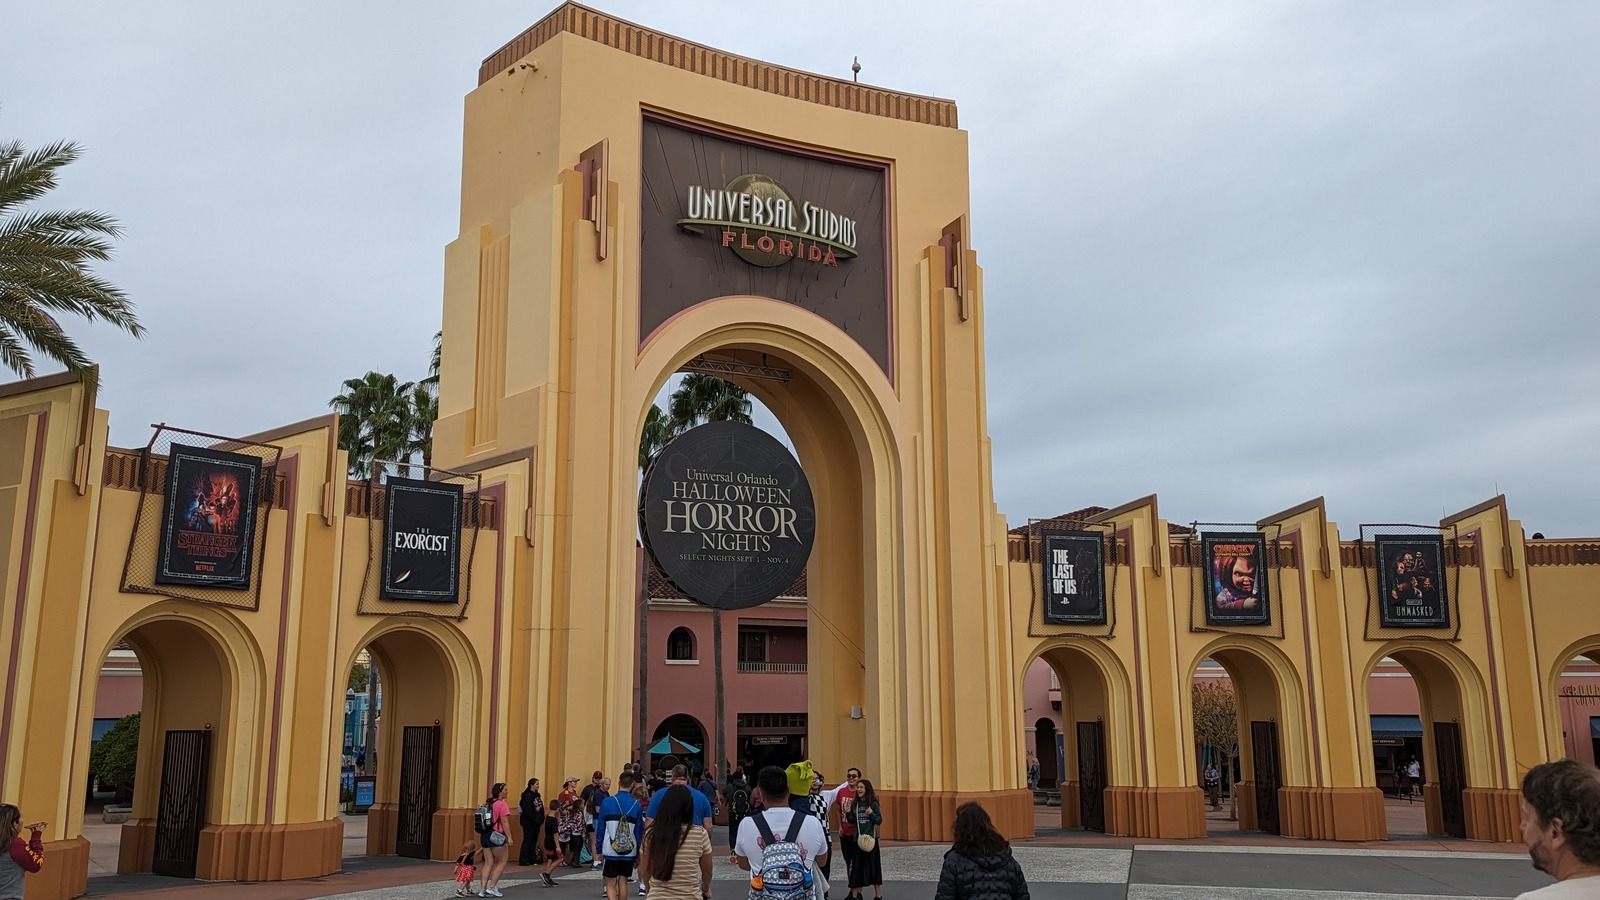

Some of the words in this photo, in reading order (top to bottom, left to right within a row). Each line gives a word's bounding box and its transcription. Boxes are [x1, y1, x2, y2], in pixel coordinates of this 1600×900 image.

[688, 185, 797, 232] UNIVERSAL
[803, 201, 857, 248] STUDIOS
[722, 231, 838, 267] FLORIDA
[686, 468, 733, 483] Universal
[737, 472, 778, 486] Orlando
[671, 481, 792, 505] HALLOWEEN
[662, 500, 803, 545] HORROR
[395, 531, 450, 551] EXORCIST
[701, 532, 771, 553] NIGHTS
[679, 553, 706, 561] SELECT
[708, 554, 735, 562] NIGHTS
[736, 555, 755, 563] SEPT.
[1052, 549, 1069, 564] THE
[195, 564, 215, 572] NETFLIX
[1052, 564, 1074, 579] LAST
[1053, 579, 1064, 594] OF
[1064, 579, 1077, 594] US
[1396, 606, 1434, 617] UNMASKED
